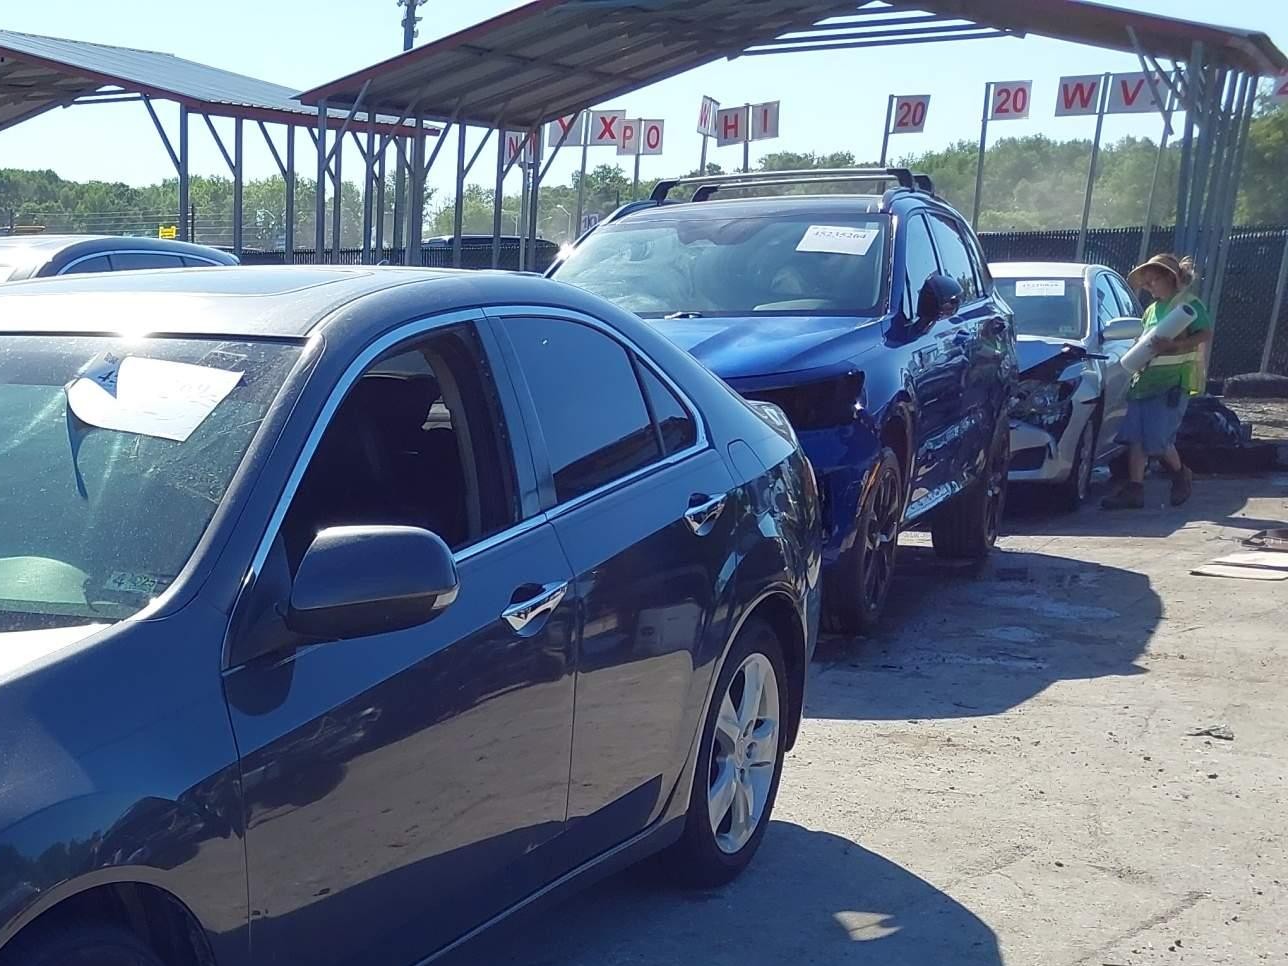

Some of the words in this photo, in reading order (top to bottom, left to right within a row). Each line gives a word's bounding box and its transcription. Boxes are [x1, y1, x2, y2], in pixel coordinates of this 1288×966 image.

[995, 87, 1028, 114] 20
[1062, 82, 1097, 109] W
[1121, 79, 1146, 106] V
[723, 113, 739, 139] H
[763, 109, 768, 133] I
[897, 101, 926, 127] 20
[597, 116, 618, 140] X
[622, 125, 634, 149] P
